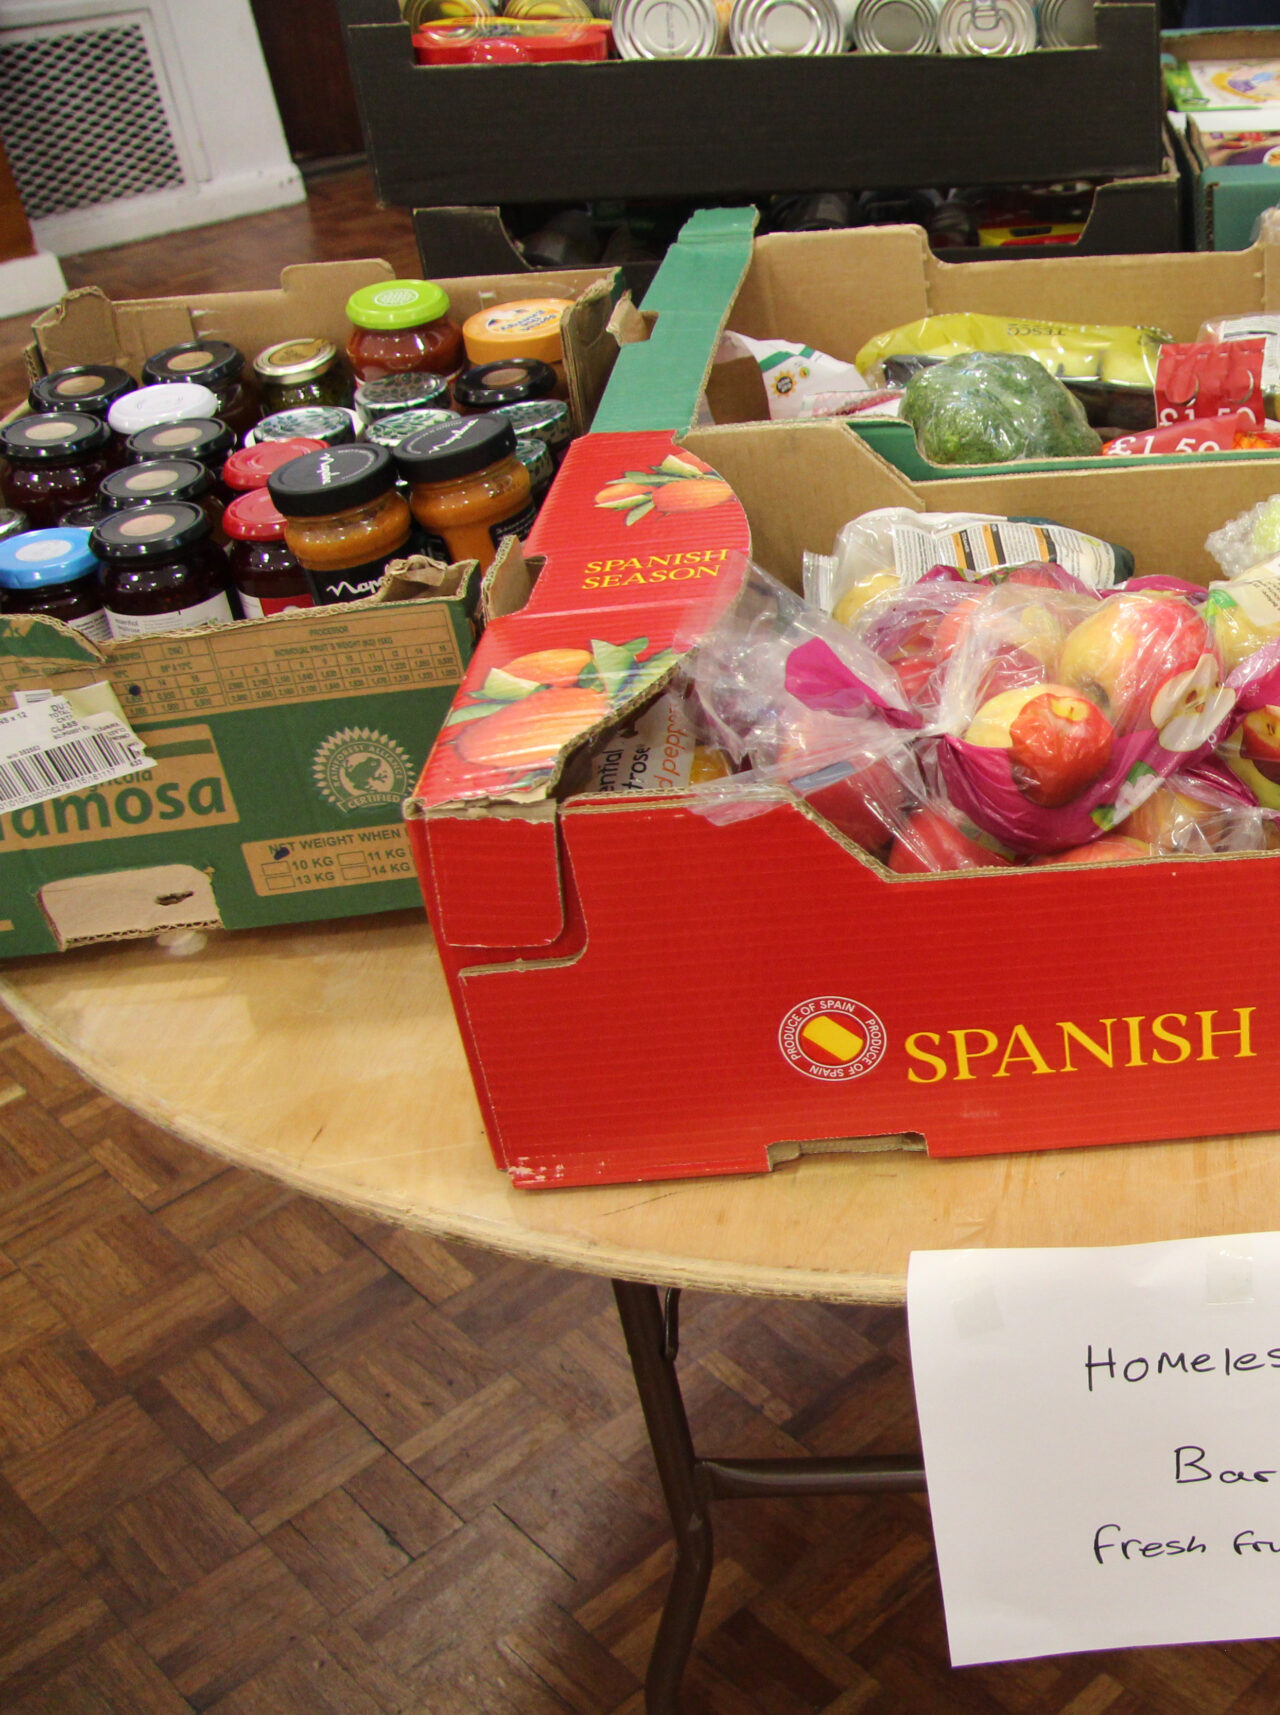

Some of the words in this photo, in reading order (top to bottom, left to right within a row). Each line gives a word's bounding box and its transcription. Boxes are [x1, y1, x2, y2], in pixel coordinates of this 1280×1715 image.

[1159, 407, 1256, 427] £10
[1107, 436, 1221, 456] £150
[584, 549, 730, 574] SPANISH
[581, 565, 721, 590] SEASON
[662, 704, 688, 777] pepp
[0, 776, 227, 841] amosa
[347, 794, 401, 809] CERTIFIED
[299, 834, 355, 851] WEIGHT
[358, 828, 401, 843] WHEN
[292, 860, 308, 871] 10
[312, 856, 334, 868] KG
[368, 851, 381, 862] 11
[384, 846, 406, 858] KG
[296, 875, 311, 885] 13
[314, 871, 335, 882] KG
[371, 866, 387, 876] 14
[390, 862, 411, 873] KG
[784, 1013, 802, 1061] PRODUCE
[800, 1002, 816, 1016] OF
[819, 1000, 856, 1013] SPAIN
[862, 1018, 882, 1065] PRODUCE
[905, 1006, 1257, 1083] SPANISH
[809, 1065, 845, 1078] SPAIN
[848, 1063, 864, 1076] OF
